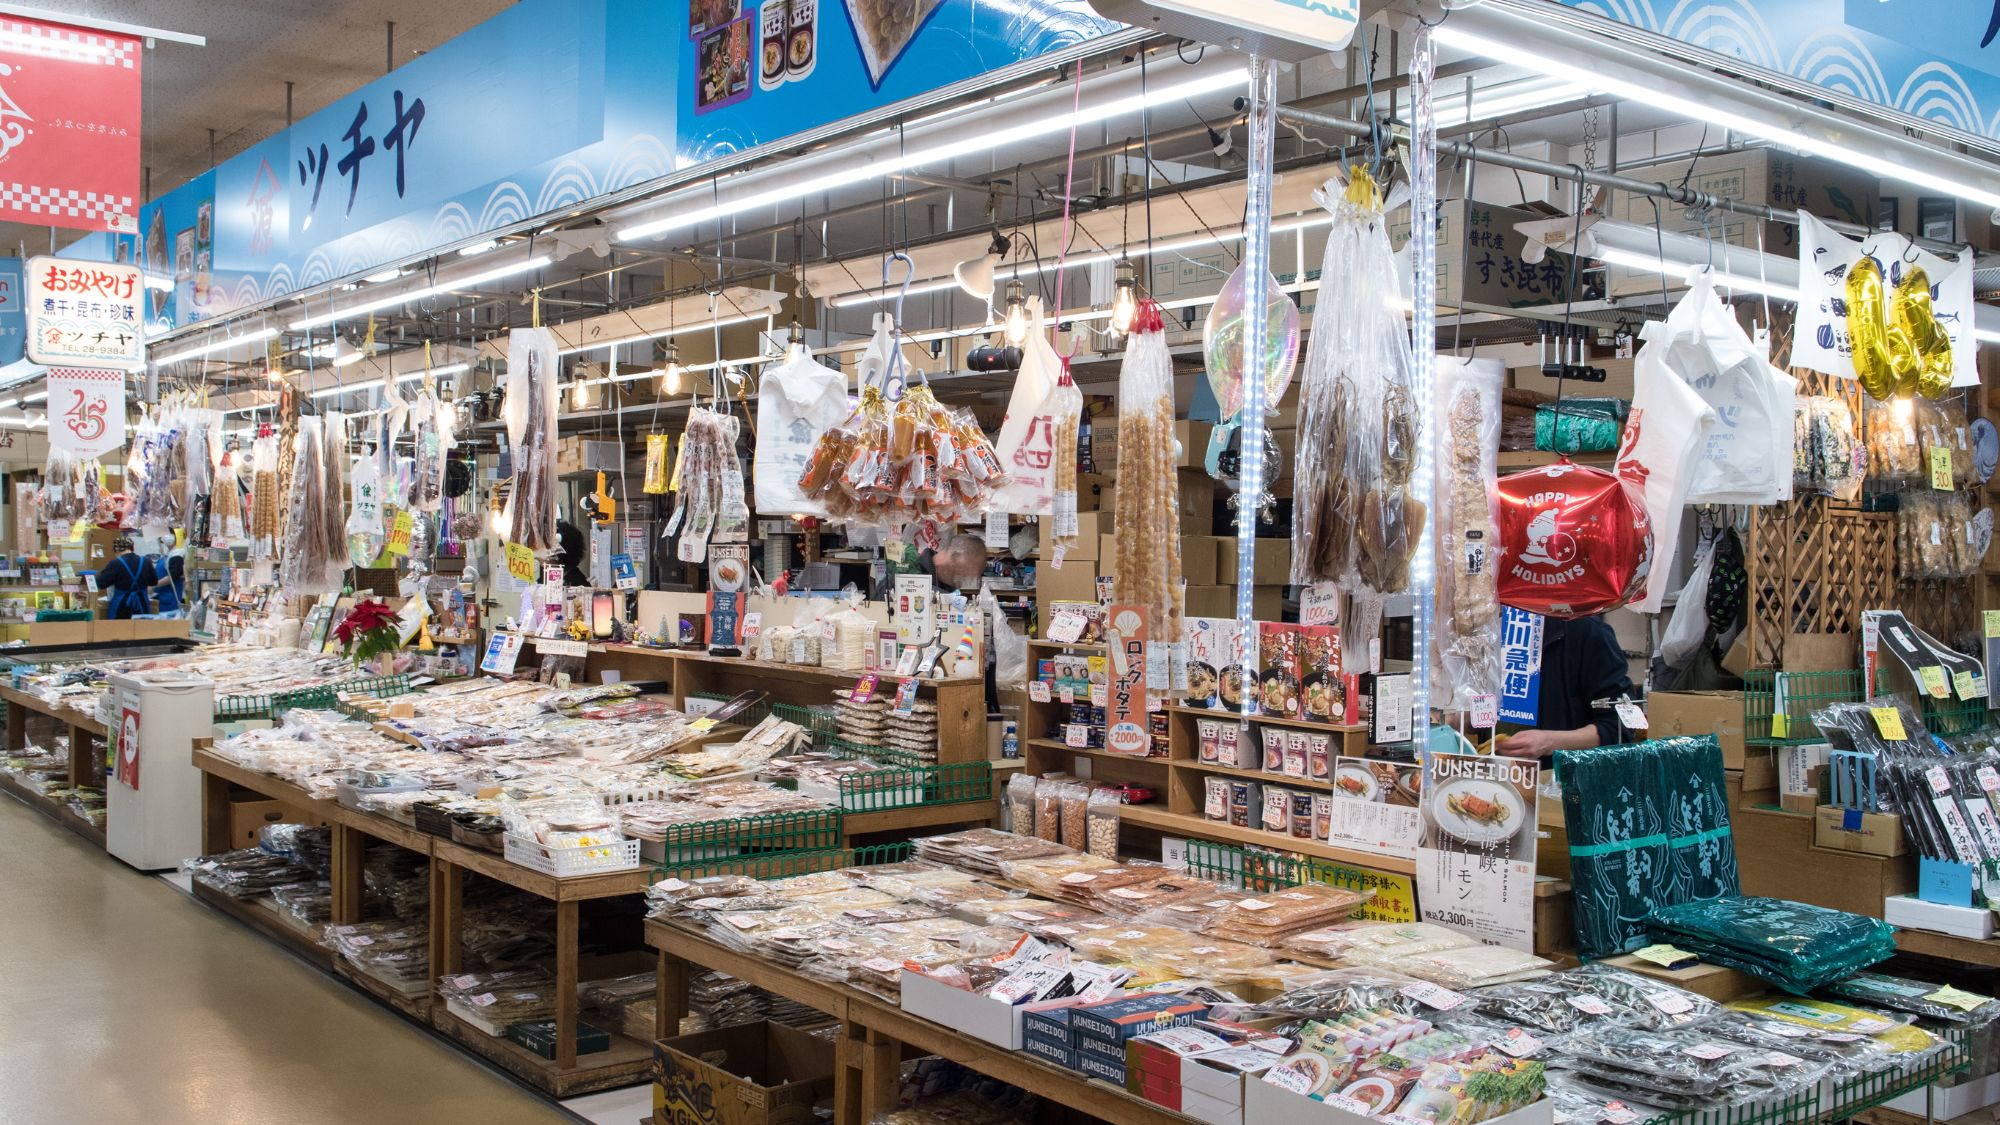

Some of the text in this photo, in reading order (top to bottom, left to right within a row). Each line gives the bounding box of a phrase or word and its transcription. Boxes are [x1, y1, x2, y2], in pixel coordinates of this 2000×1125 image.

[297, 89, 426, 232] ツチヤ
[42, 265, 137, 299] おみやげ
[1475, 252, 1565, 297] すき昆布
[43, 298, 135, 321] 煮干・昆布・珍味
[67, 331, 133, 346] ツチヤ
[1523, 491, 1577, 508] HAPPY
[1511, 563, 1585, 585] HOLIDAYS
[1115, 677, 1130, 721] ホタテ
[1499, 708, 1534, 720] SAGAWA
[1457, 828, 1475, 901] サーモン
[1479, 830, 1499, 874] 海峡
[1501, 868, 1509, 903] SALMON
[1027, 1018, 1067, 1042] KUNSEIDOU
[1073, 1014, 1116, 1039] KUNSEIDOU
[1027, 1038, 1067, 1063] KUNSEIDOU
[1083, 1036, 1127, 1062] KUNSEIDOU
[1081, 1058, 1125, 1084] KUNSEIDOU
